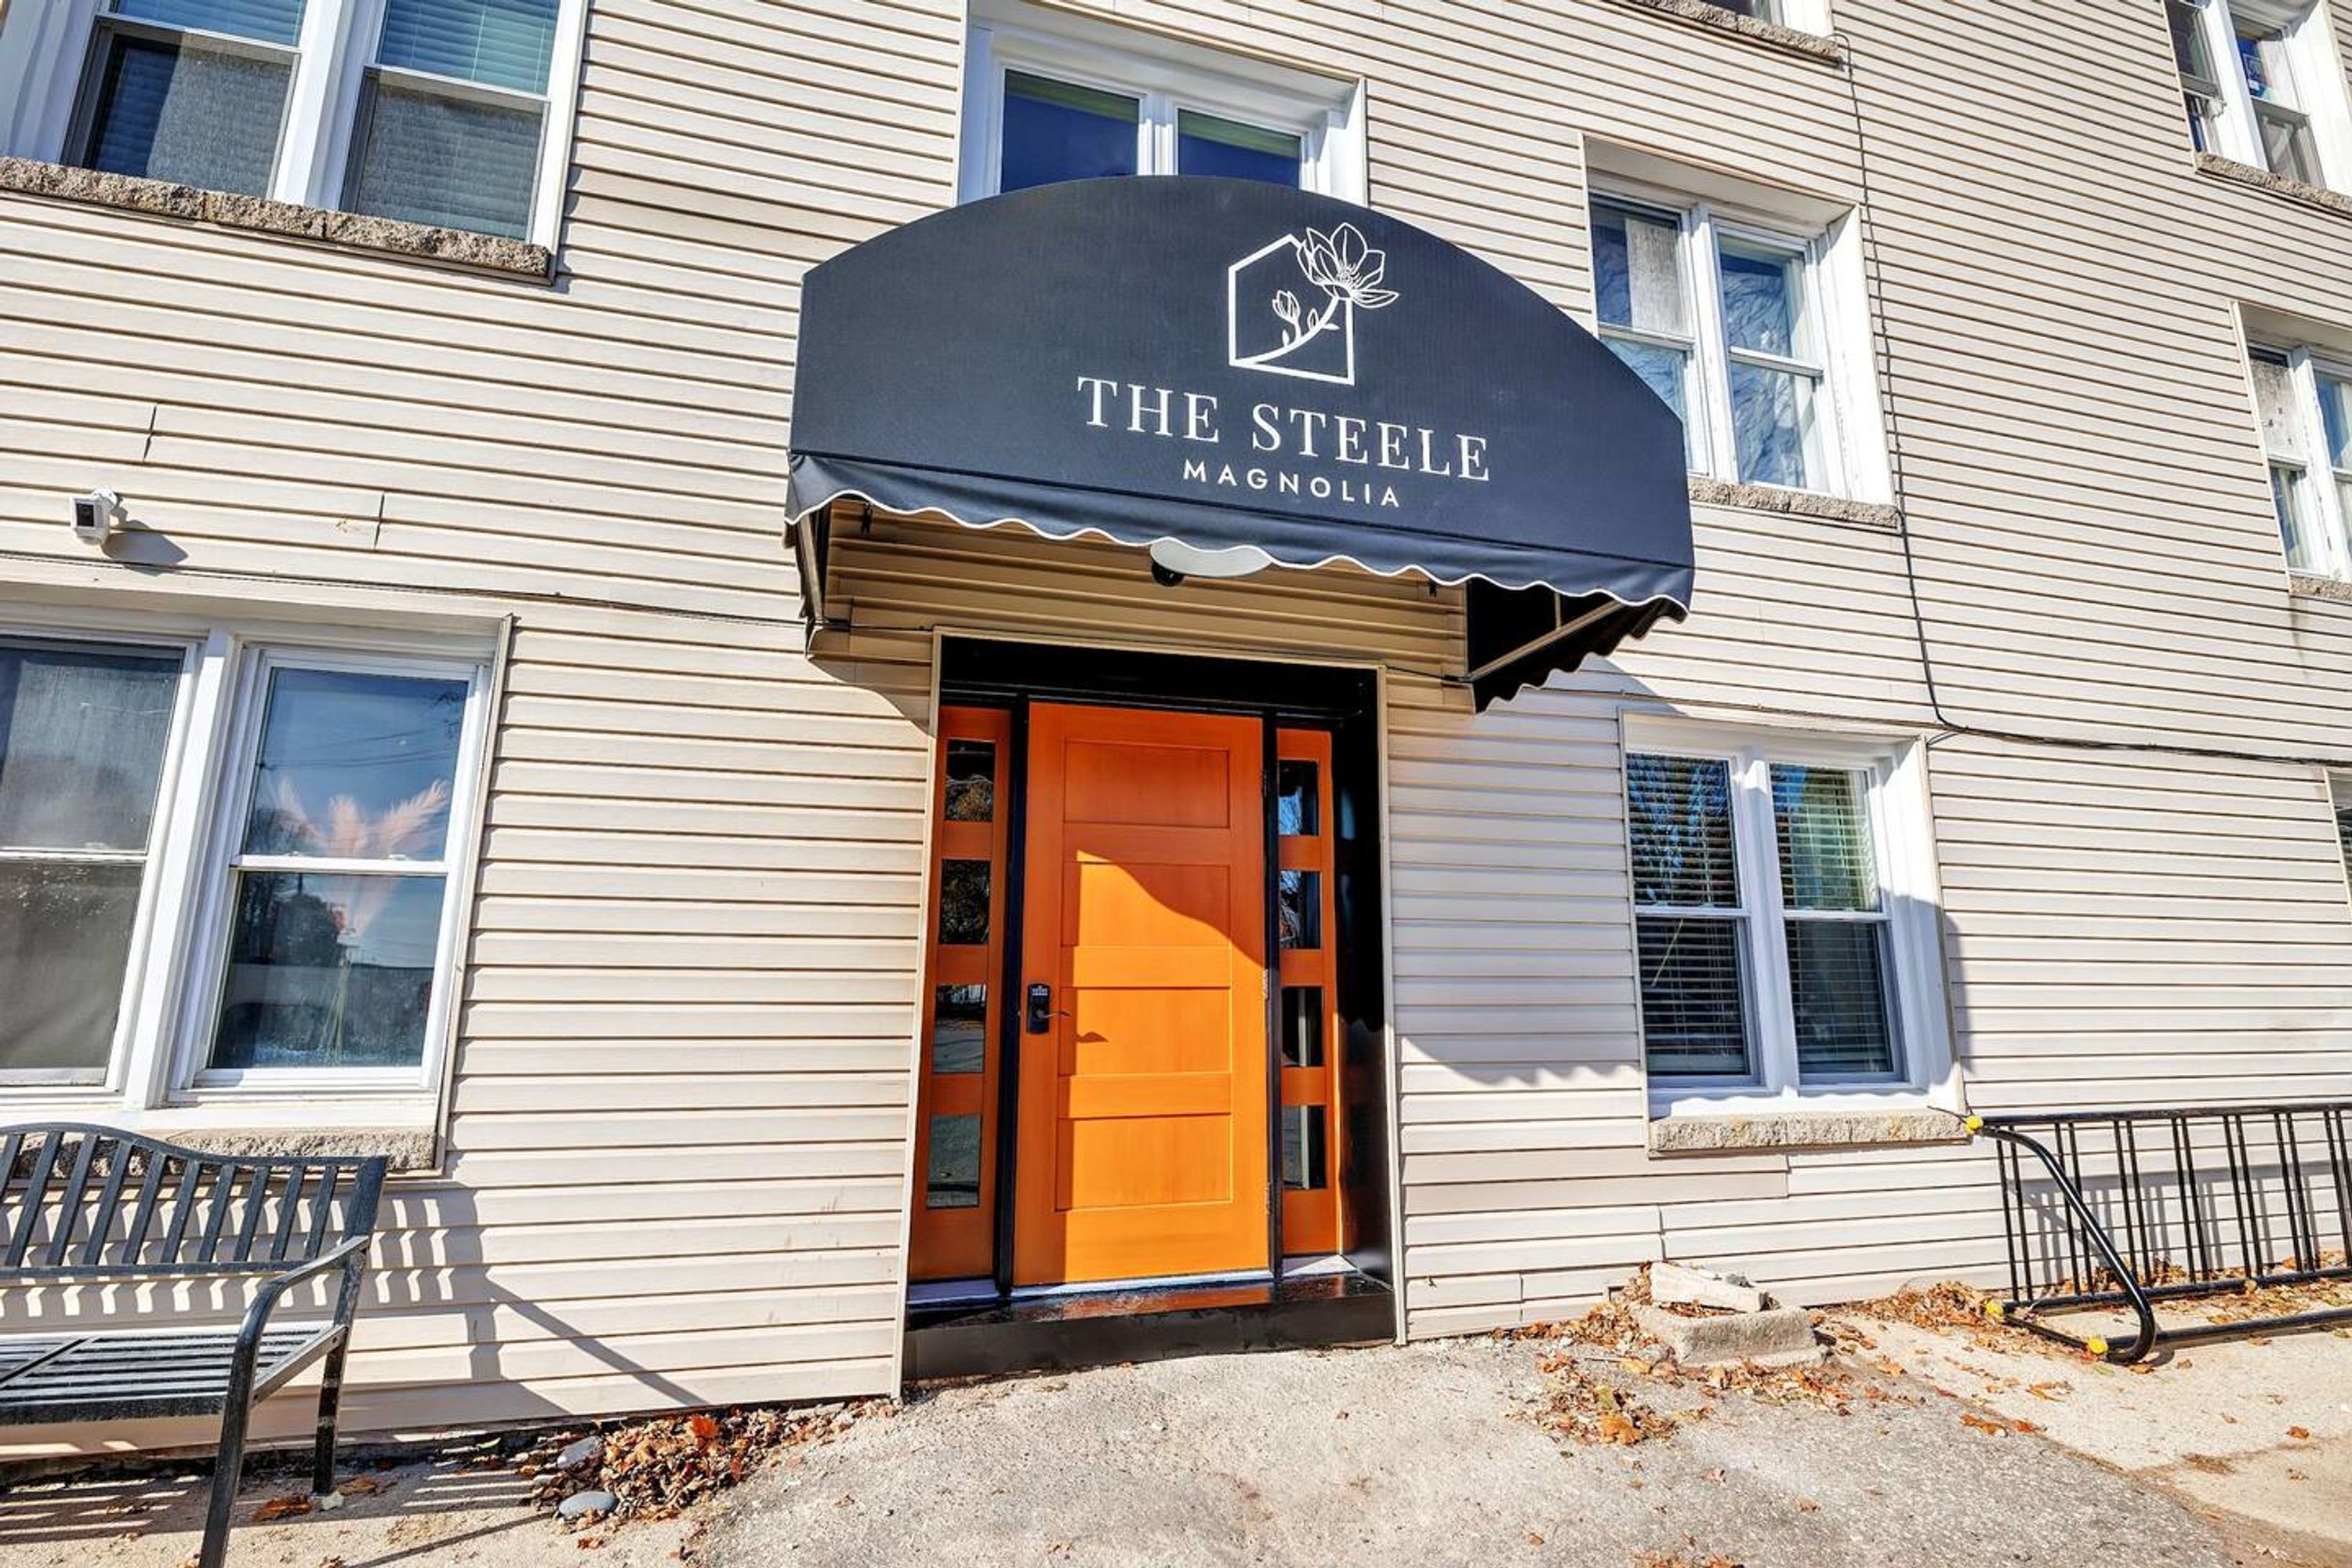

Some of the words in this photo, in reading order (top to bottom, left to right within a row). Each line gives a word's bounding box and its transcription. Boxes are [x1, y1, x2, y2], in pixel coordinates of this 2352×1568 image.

[1076, 376, 1220, 444] THE
[1252, 403, 1490, 481] STEELE
[1182, 459, 1399, 508] MAGNOLIA
